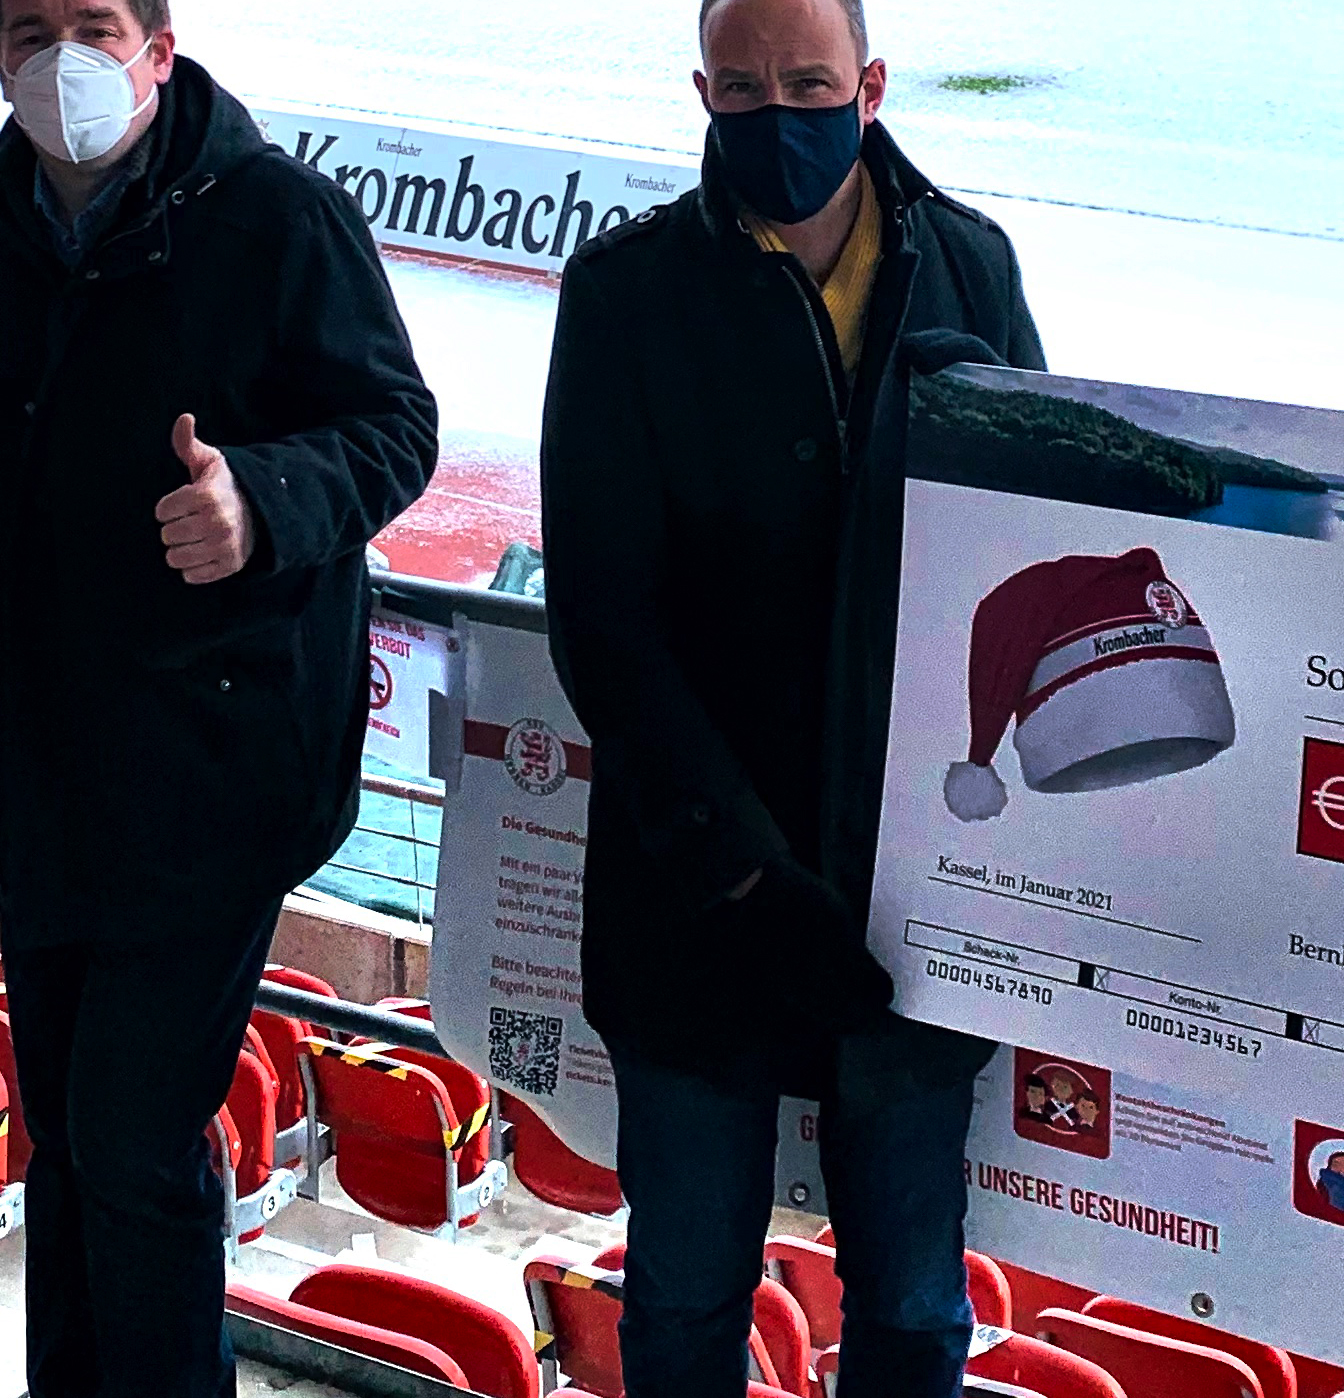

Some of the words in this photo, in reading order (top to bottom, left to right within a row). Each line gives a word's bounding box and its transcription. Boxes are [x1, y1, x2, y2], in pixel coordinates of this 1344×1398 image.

[376, 137, 423, 157] Krombacher
[624, 173, 677, 194] Krombacher
[1093, 626, 1166, 656] Krombacher
[502, 815, 522, 831] Die
[525, 821, 587, 846] Gesundhe
[938, 856, 991, 885] Kassel,
[995, 870, 1016, 889] im
[1020, 875, 1074, 904] Januar
[1076, 887, 1113, 912] 2021
[926, 958, 1053, 1006] 00004567890
[1169, 991, 1222, 1014] Konto-Nr.
[1126, 1008, 1262, 1058] 00001234567
[268, 1196, 276, 1211] 3
[483, 1185, 491, 1200] 2
[979, 1162, 1064, 1210] UNSERE
[1070, 1187, 1221, 1254] GESUNDHEIT!
